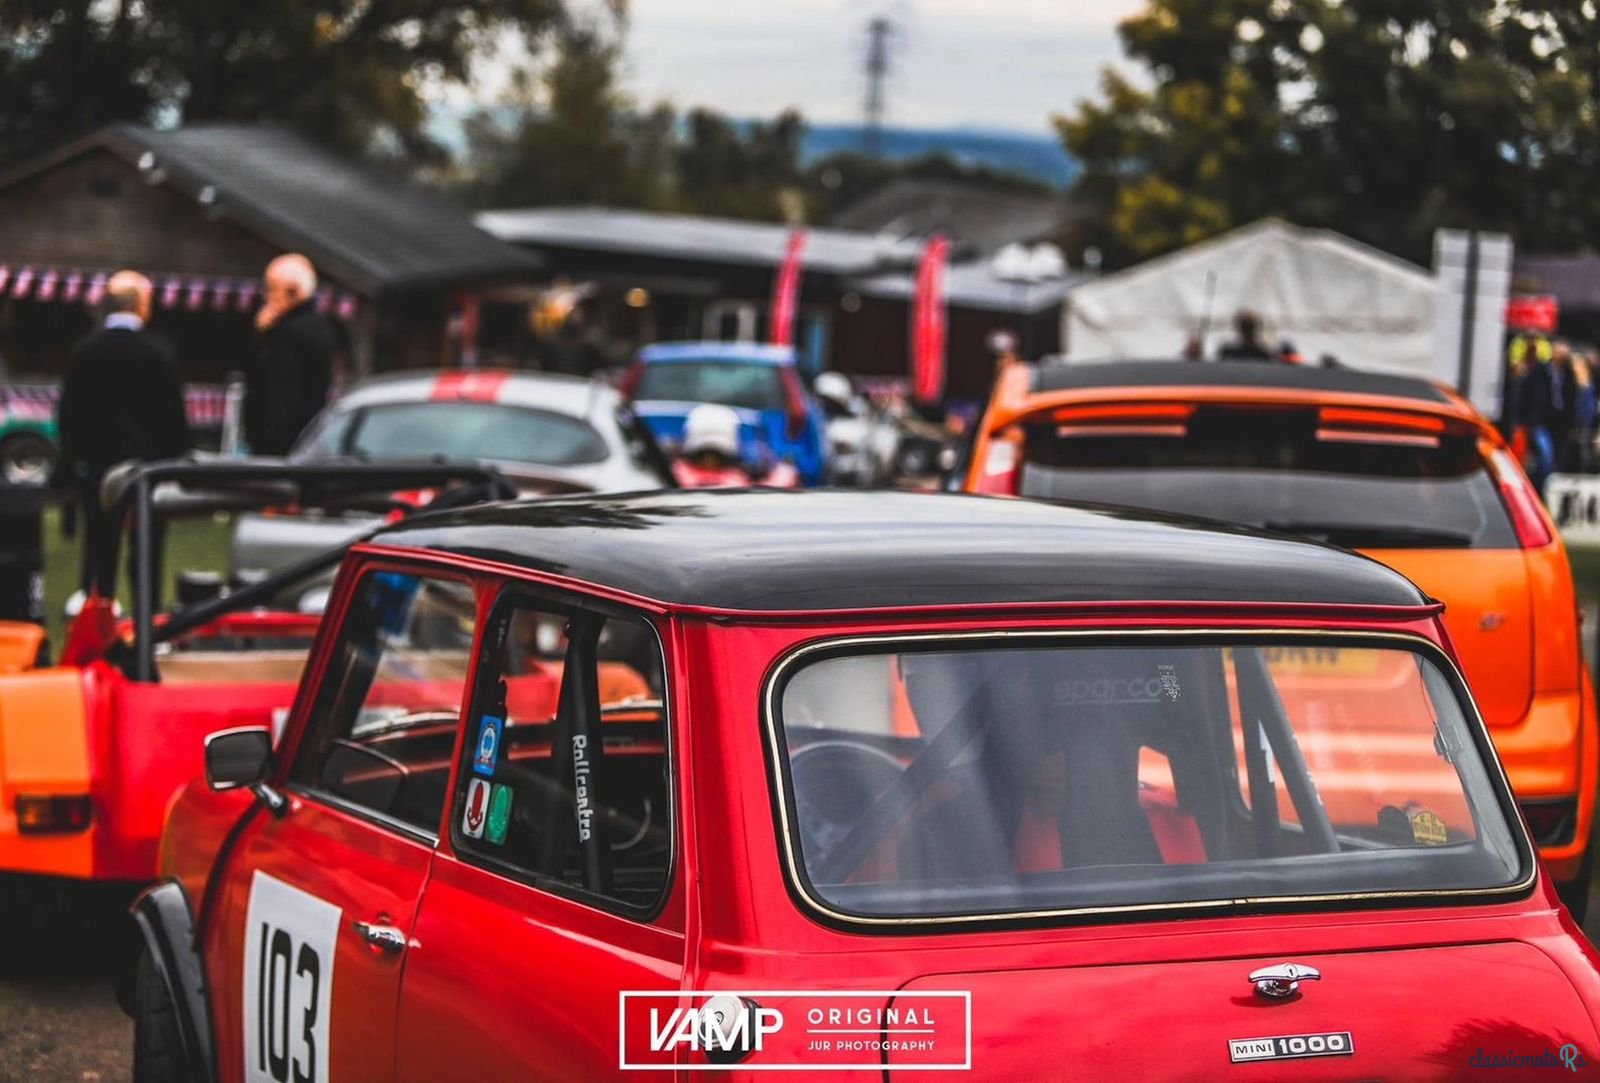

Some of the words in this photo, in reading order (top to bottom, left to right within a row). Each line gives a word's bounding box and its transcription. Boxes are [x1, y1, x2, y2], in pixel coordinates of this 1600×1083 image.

[1054, 678, 1162, 701] sparco
[258, 921, 321, 1083] 103
[1235, 1043, 1273, 1055] MINI
[1278, 1034, 1345, 1055] 1000
